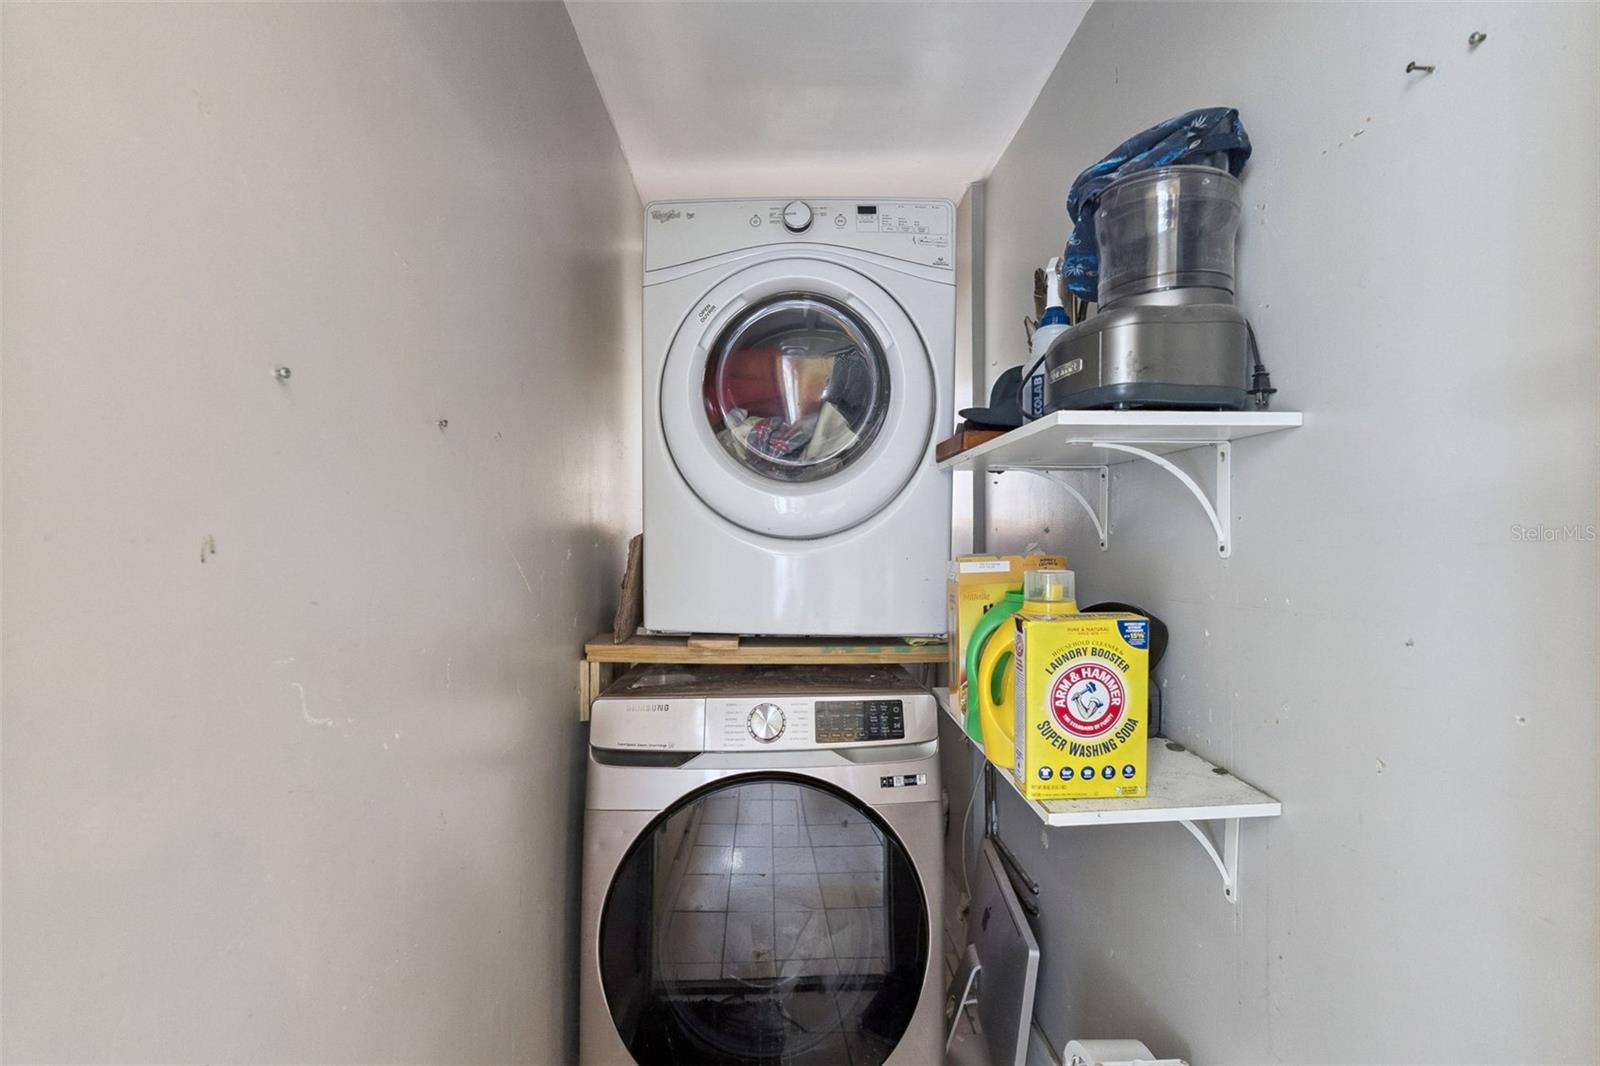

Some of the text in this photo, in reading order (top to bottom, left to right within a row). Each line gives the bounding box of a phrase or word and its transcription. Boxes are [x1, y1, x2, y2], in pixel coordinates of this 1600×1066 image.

[698, 303, 711, 318] OPEN
[1033, 376, 1043, 416] COLAB
[1045, 647, 1089, 676] LAUNDRY
[1091, 647, 1130, 673] BOOSTER
[1051, 640, 1090, 657] HOUSEHOLD
[1091, 640, 1121, 653] CLEANER
[1055, 667, 1121, 708] ARM & HAMMER
[1037, 718, 1139, 758] SUPER WASHING SODA
